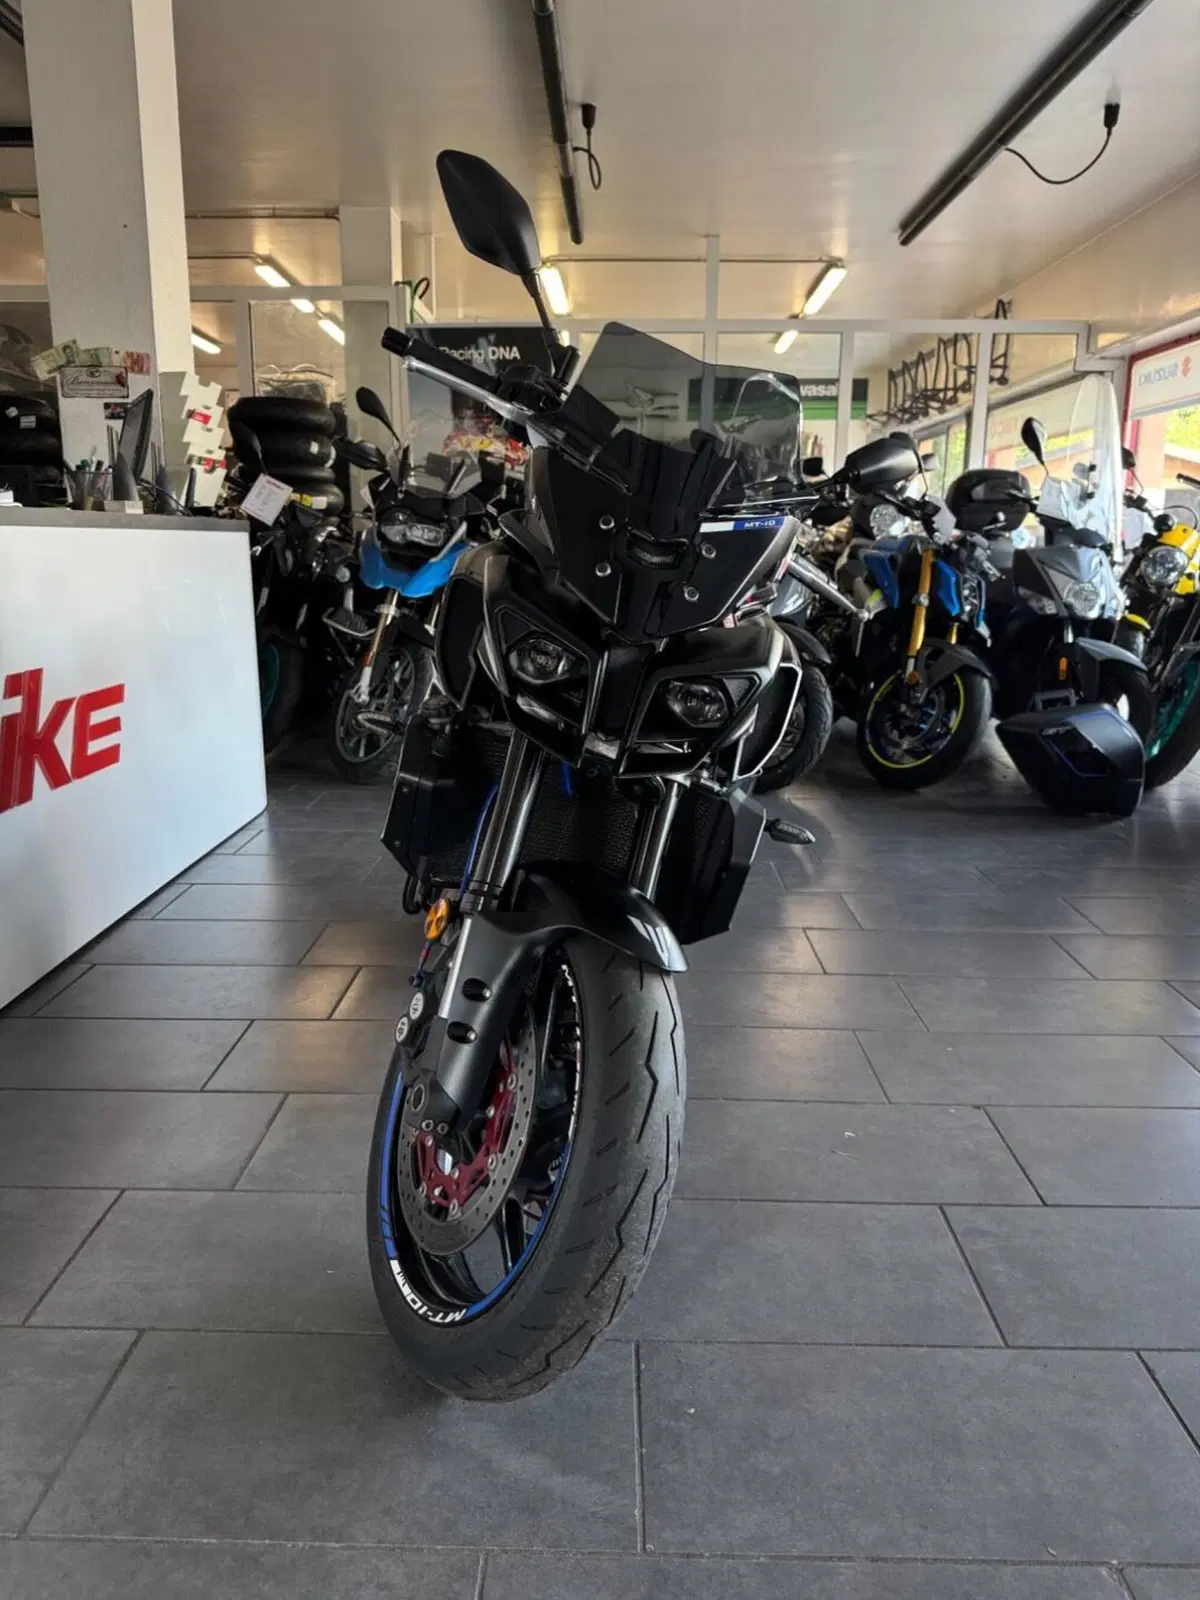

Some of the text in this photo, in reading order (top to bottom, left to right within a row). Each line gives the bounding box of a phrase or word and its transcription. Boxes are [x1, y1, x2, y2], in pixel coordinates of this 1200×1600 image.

[488, 345, 521, 360] DNA
[743, 520, 776, 528] MT-10
[405, 1292, 468, 1323] MT-10
